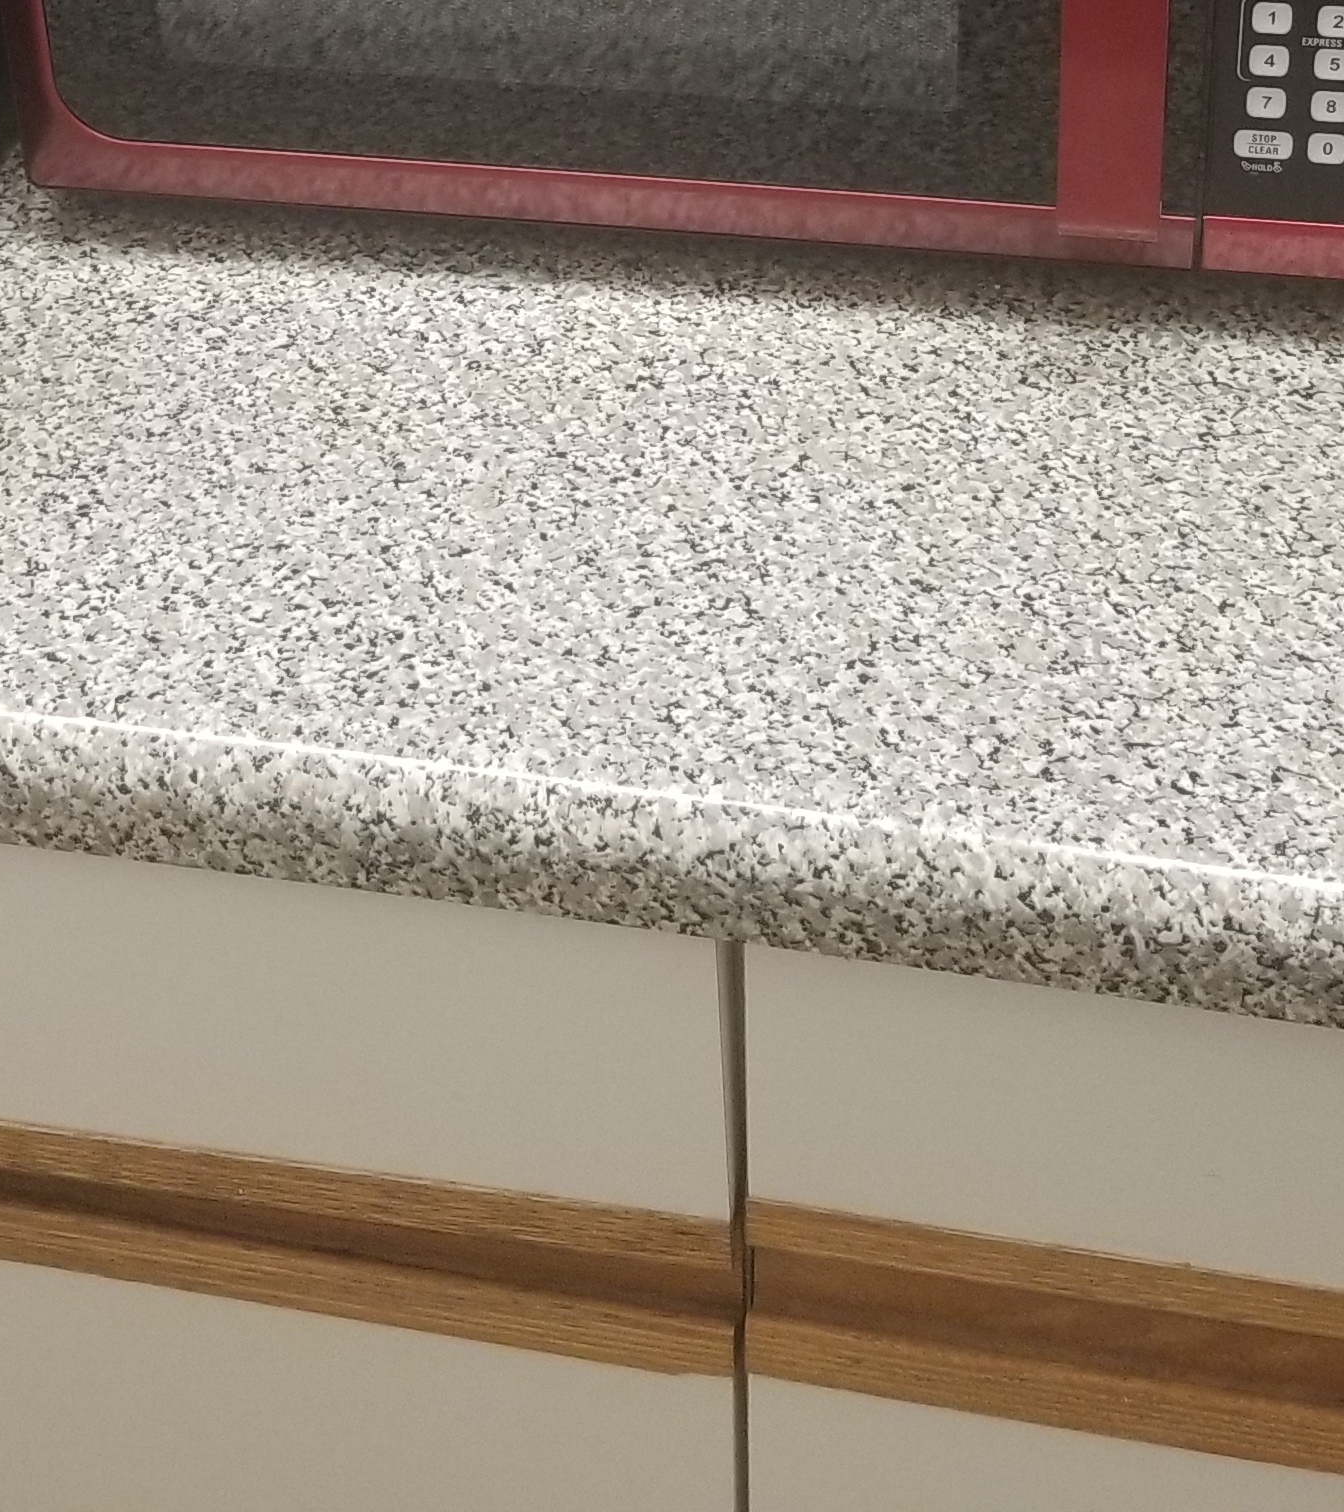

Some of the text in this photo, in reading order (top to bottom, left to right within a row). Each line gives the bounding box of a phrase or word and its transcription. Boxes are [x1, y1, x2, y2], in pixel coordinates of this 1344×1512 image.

[1267, 11, 1277, 25] 1
[1332, 15, 1344, 29] 2
[1301, 37, 1343, 48] EXPRESS
[1264, 54, 1276, 68] 4
[1329, 58, 1341, 72] 5
[1261, 95, 1273, 109] 7
[1326, 100, 1337, 114] 8
[1251, 134, 1277, 143] STOP
[1248, 145, 1279, 156] CLEAR
[1322, 142, 1333, 155] 0
